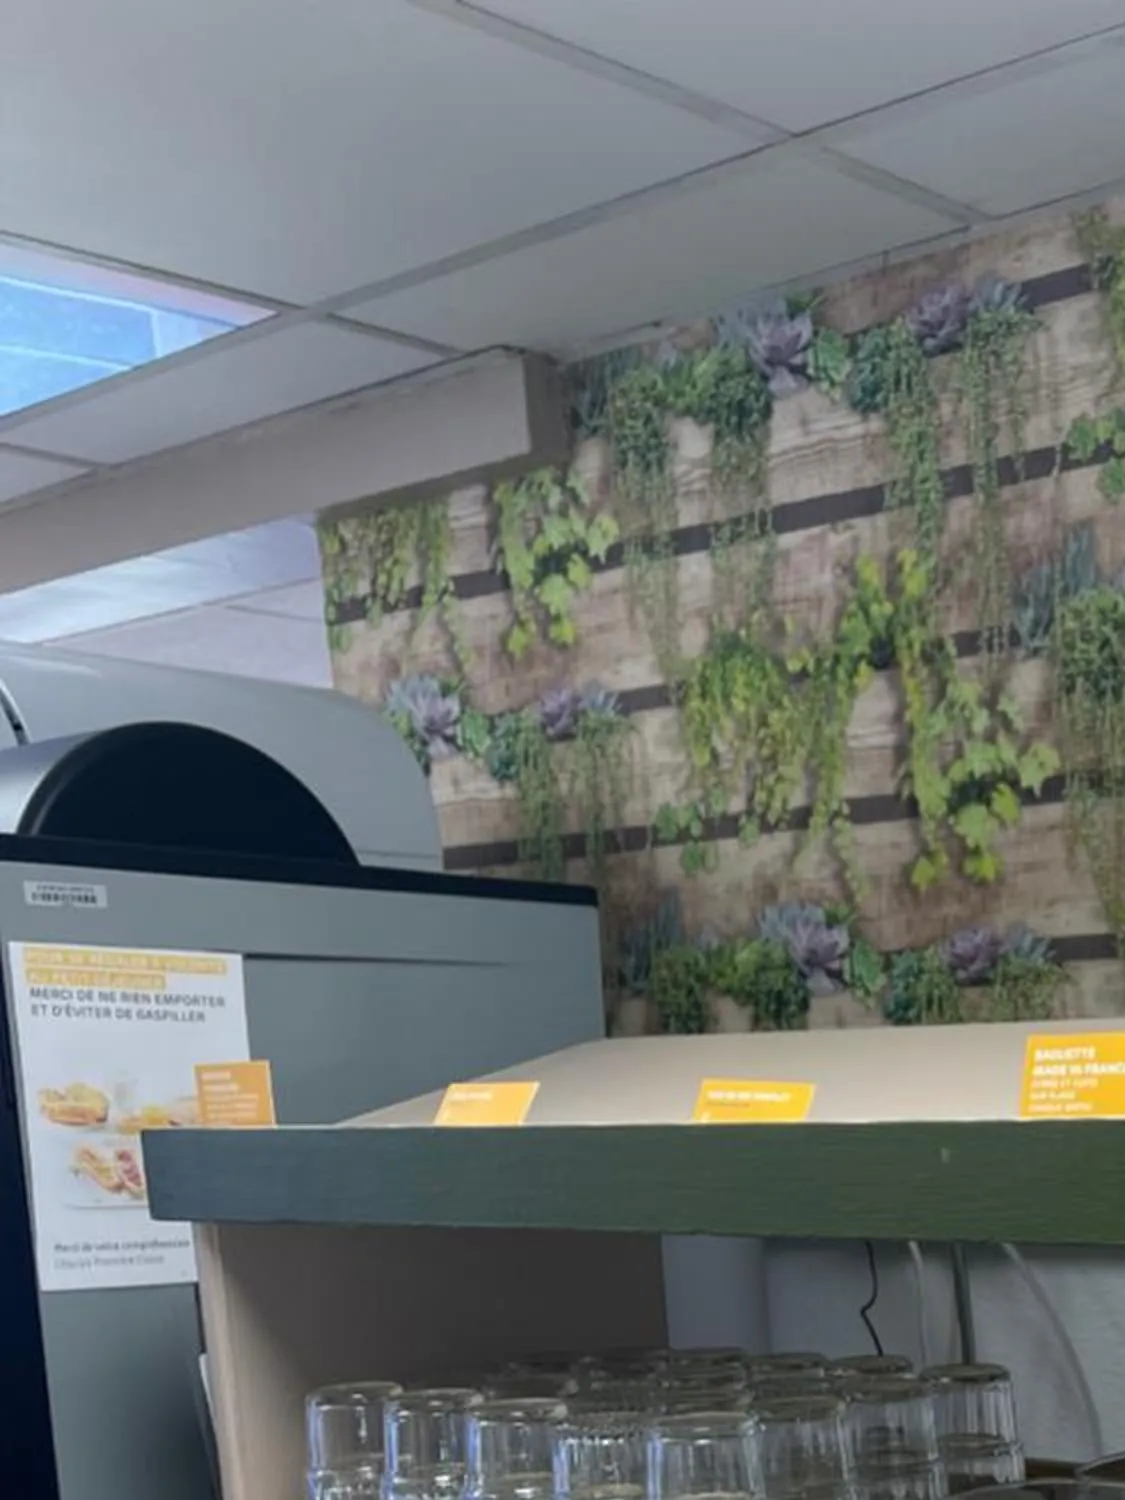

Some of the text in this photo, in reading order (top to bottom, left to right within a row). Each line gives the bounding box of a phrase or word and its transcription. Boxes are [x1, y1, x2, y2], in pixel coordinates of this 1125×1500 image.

[30, 987, 226, 1008] MERCI DE NE RIEN EMPORTER
[31, 1003, 206, 1023] ET D'ÉVITER DE GASPILLER
